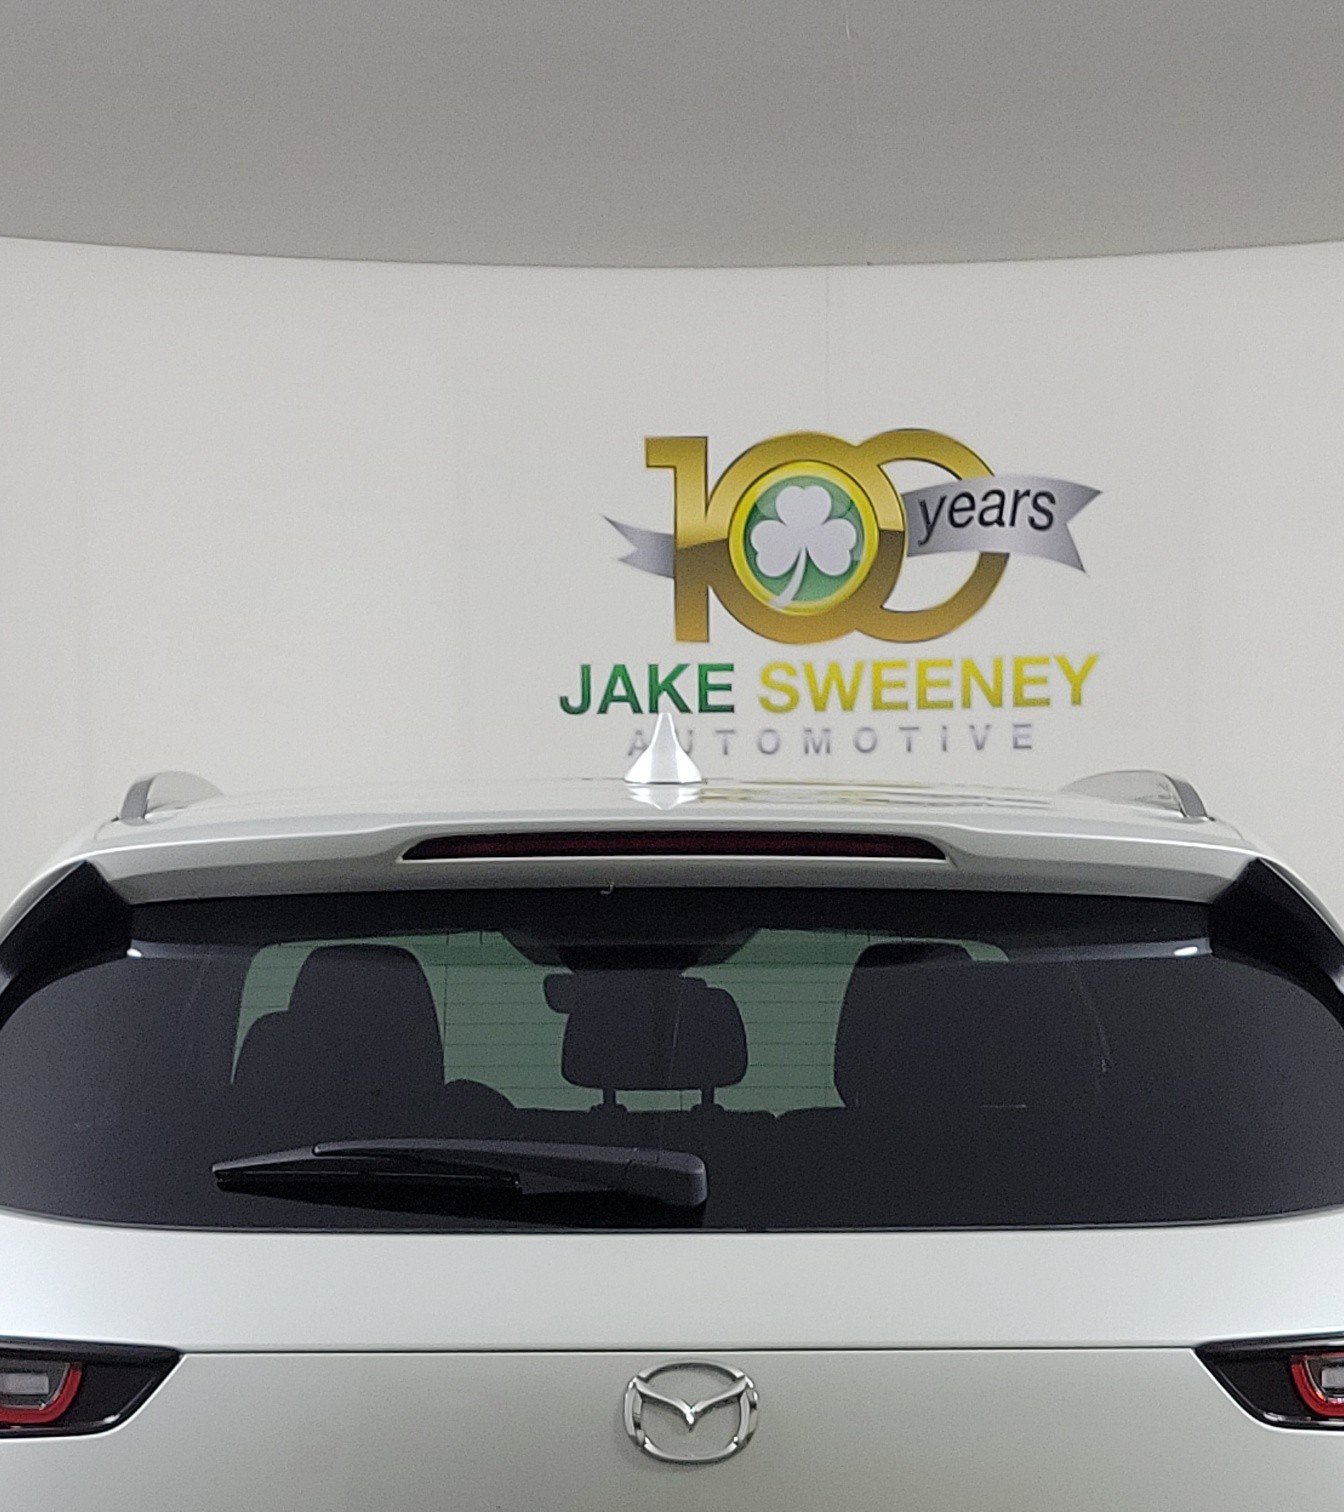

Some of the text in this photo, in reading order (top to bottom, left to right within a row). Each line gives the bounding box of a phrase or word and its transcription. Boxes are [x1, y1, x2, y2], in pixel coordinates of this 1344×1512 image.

[645, 428, 1056, 644] 100 years
[559, 654, 1100, 714] JAKE SWEENEY
